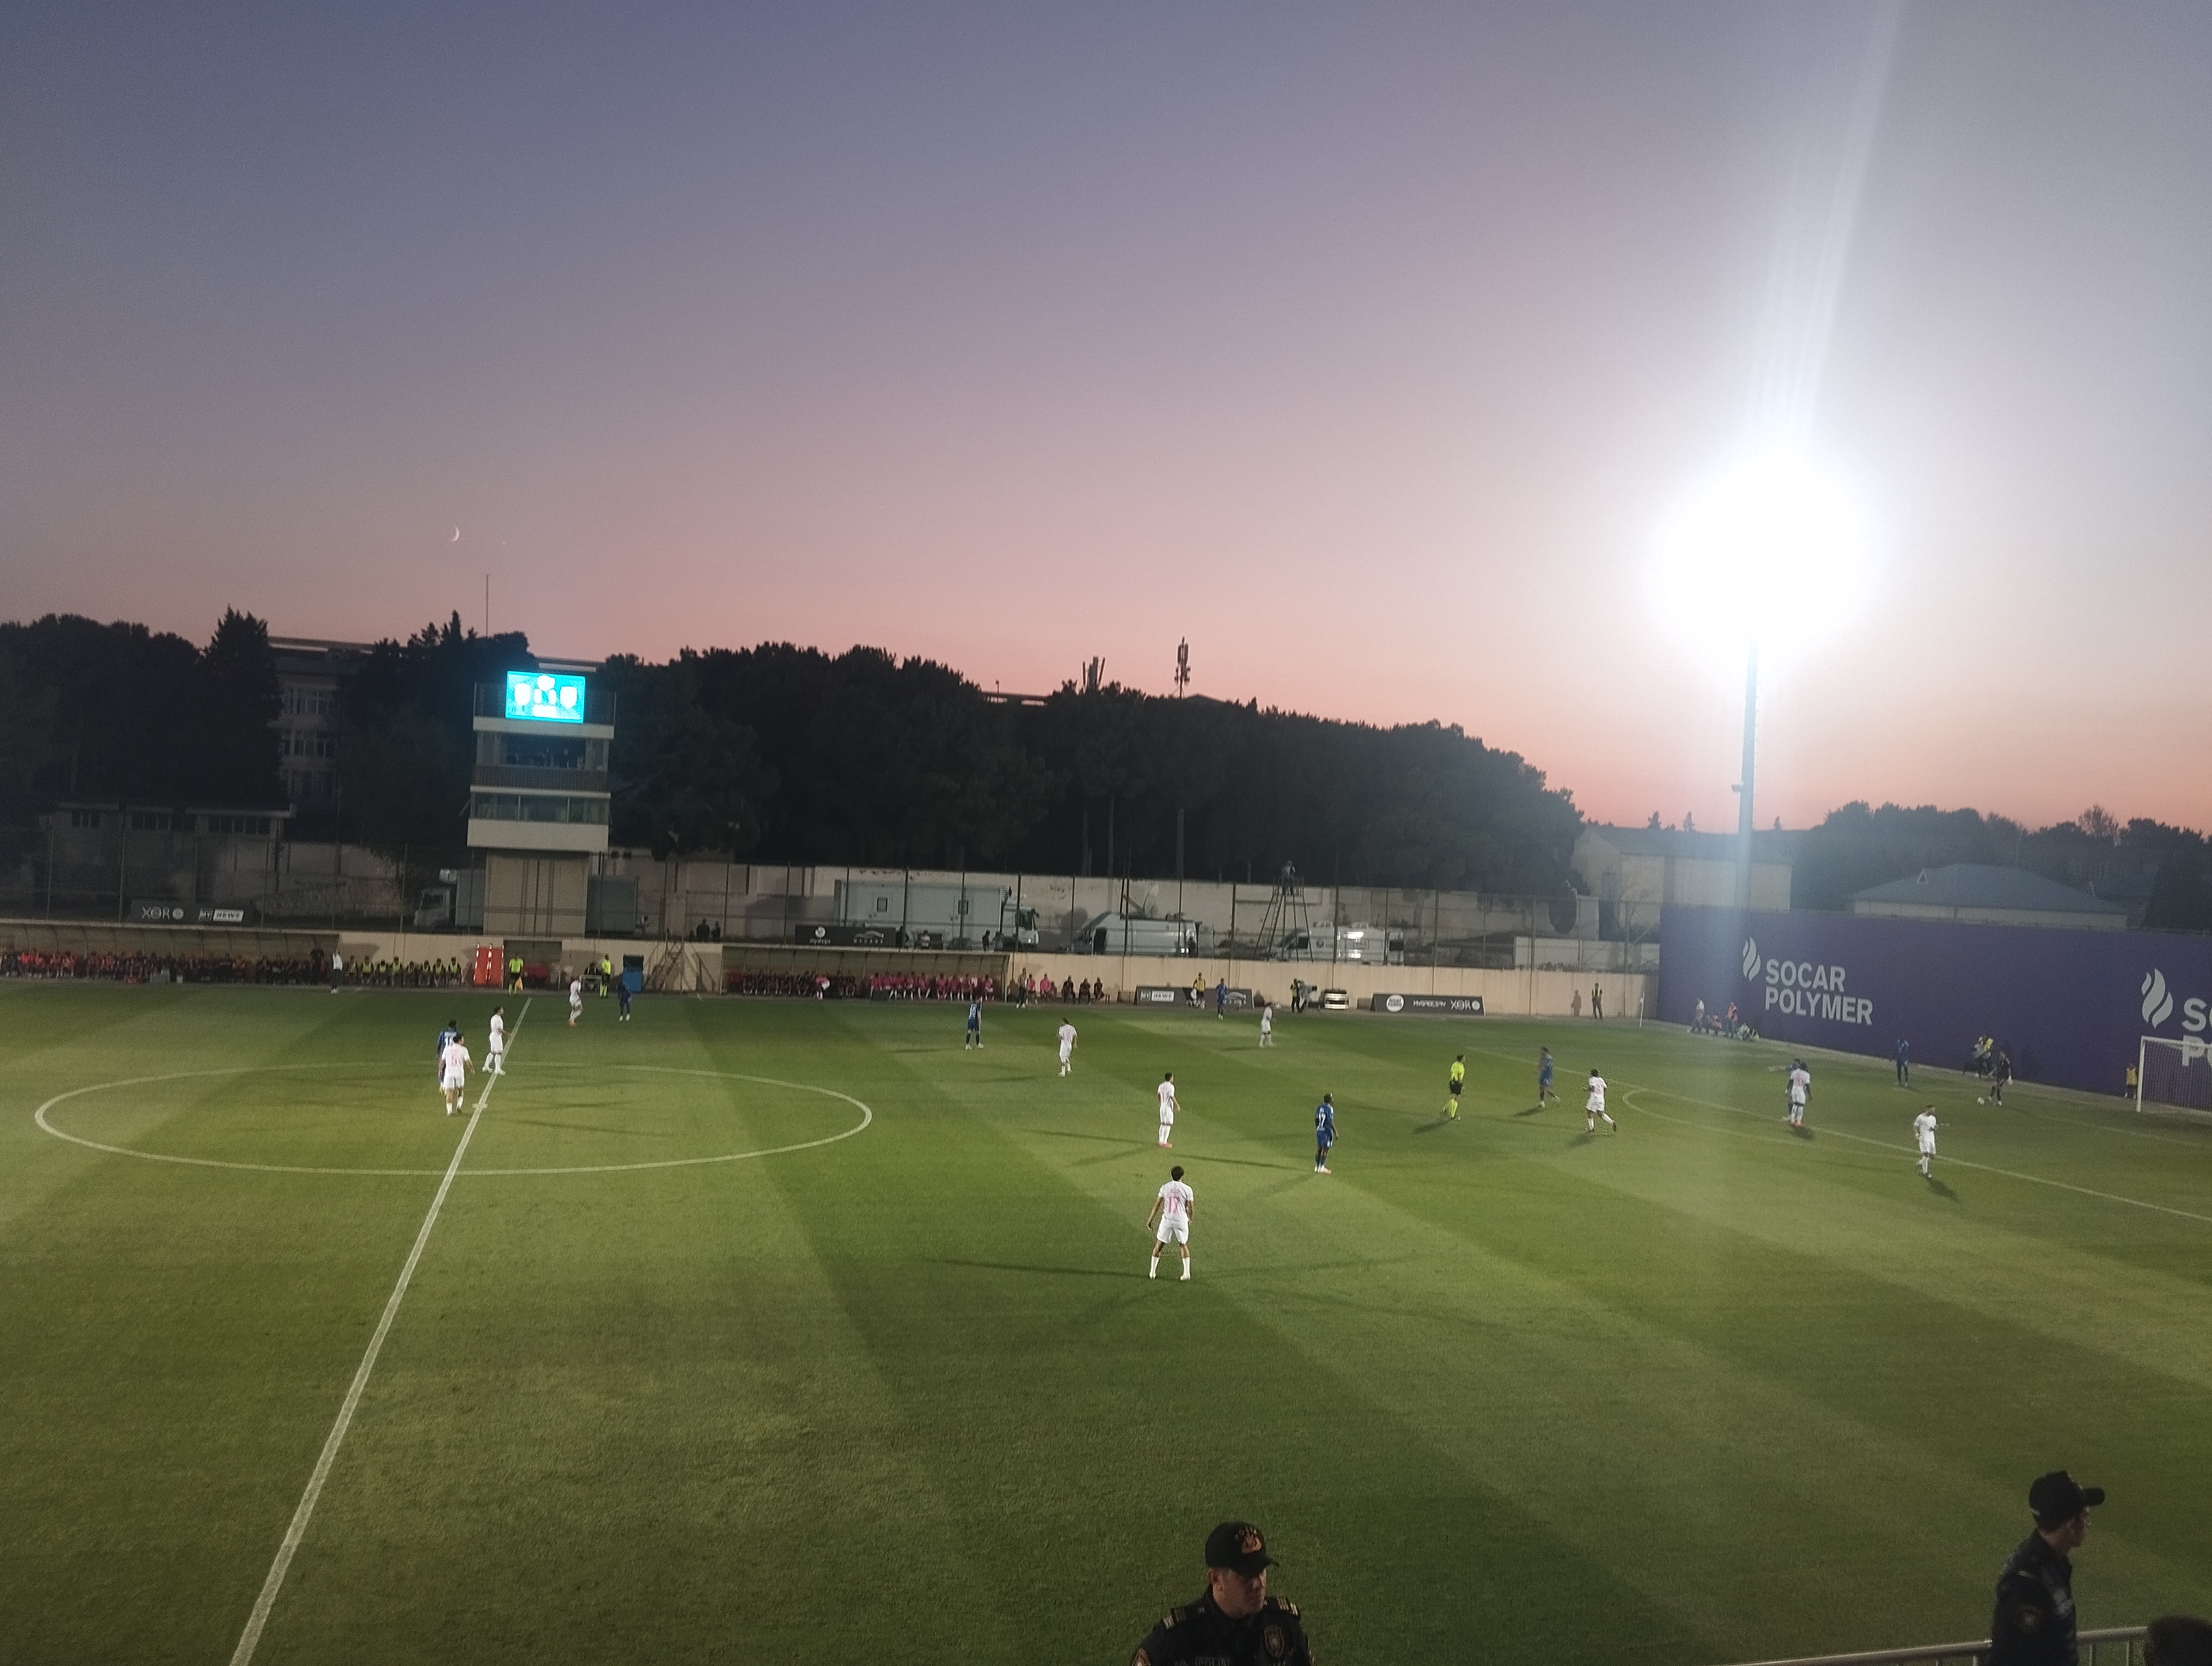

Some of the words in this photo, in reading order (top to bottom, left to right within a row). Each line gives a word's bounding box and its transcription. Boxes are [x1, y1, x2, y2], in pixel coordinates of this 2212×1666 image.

[1766, 958, 1846, 992] SOCAR
[1765, 986, 1873, 1025] POLYMER
[2182, 997, 2212, 1031] S
[2182, 1035, 2212, 1066] P
